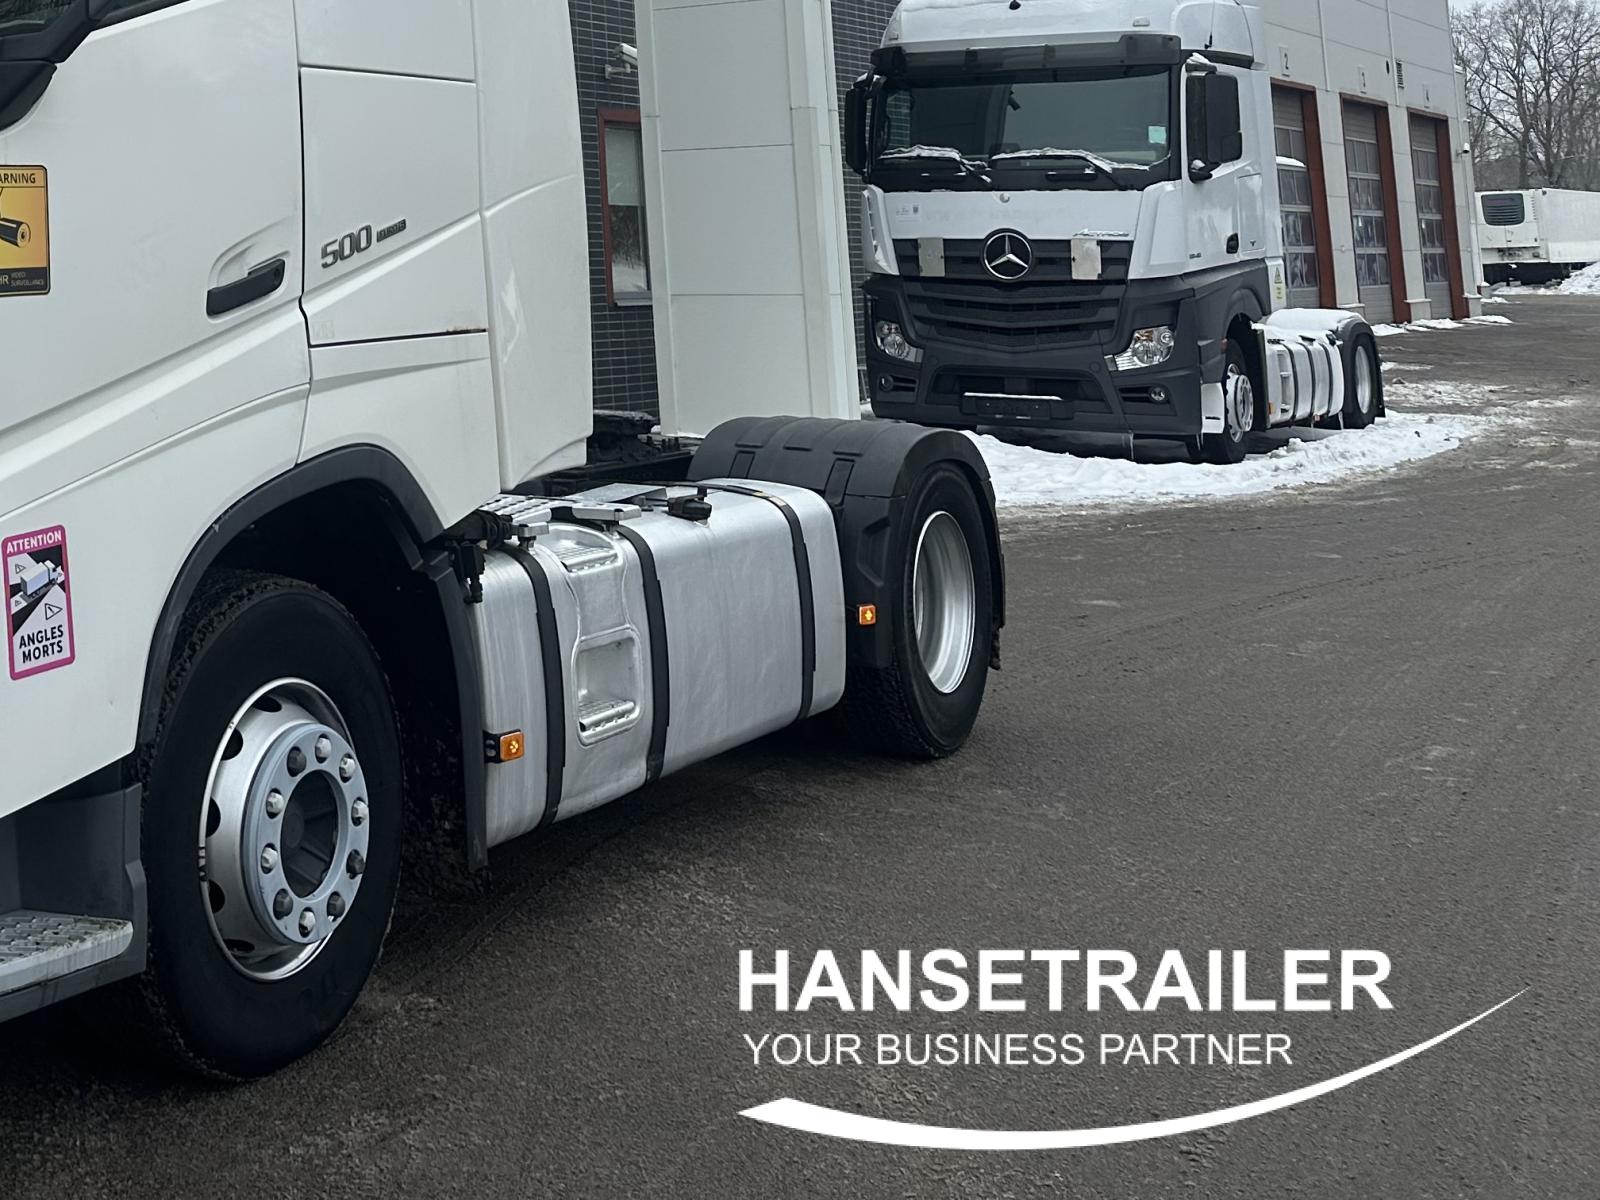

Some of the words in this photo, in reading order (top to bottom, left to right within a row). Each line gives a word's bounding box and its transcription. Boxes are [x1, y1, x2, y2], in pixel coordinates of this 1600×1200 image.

[321, 224, 373, 269] 500
[6, 530, 62, 554] ATTENTION
[19, 624, 64, 649] ANGLES
[22, 640, 63, 663] MORTS
